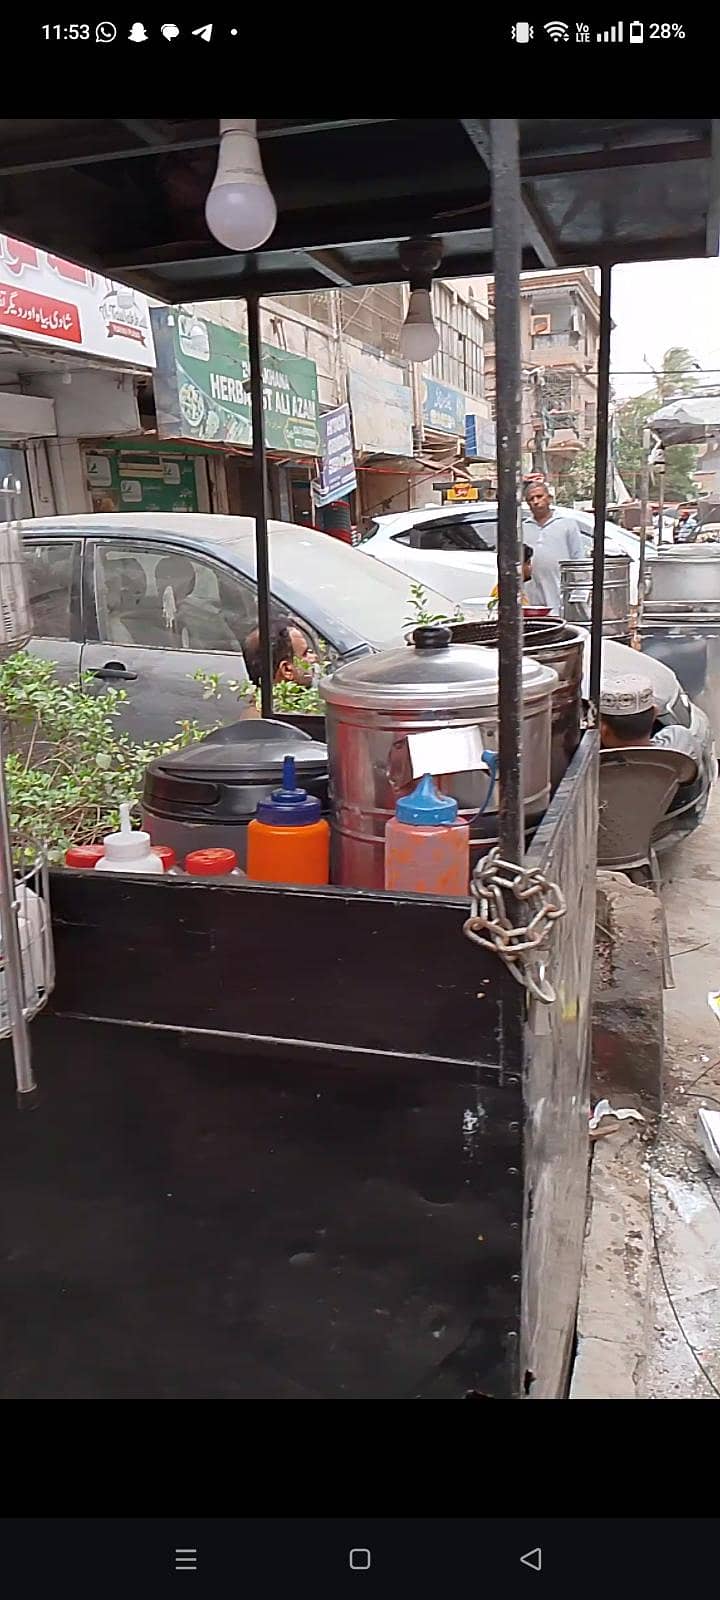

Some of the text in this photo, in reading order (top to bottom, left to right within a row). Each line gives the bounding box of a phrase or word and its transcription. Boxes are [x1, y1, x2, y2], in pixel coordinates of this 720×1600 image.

[209, 372, 316, 421] HERBAST ALI AZAM
